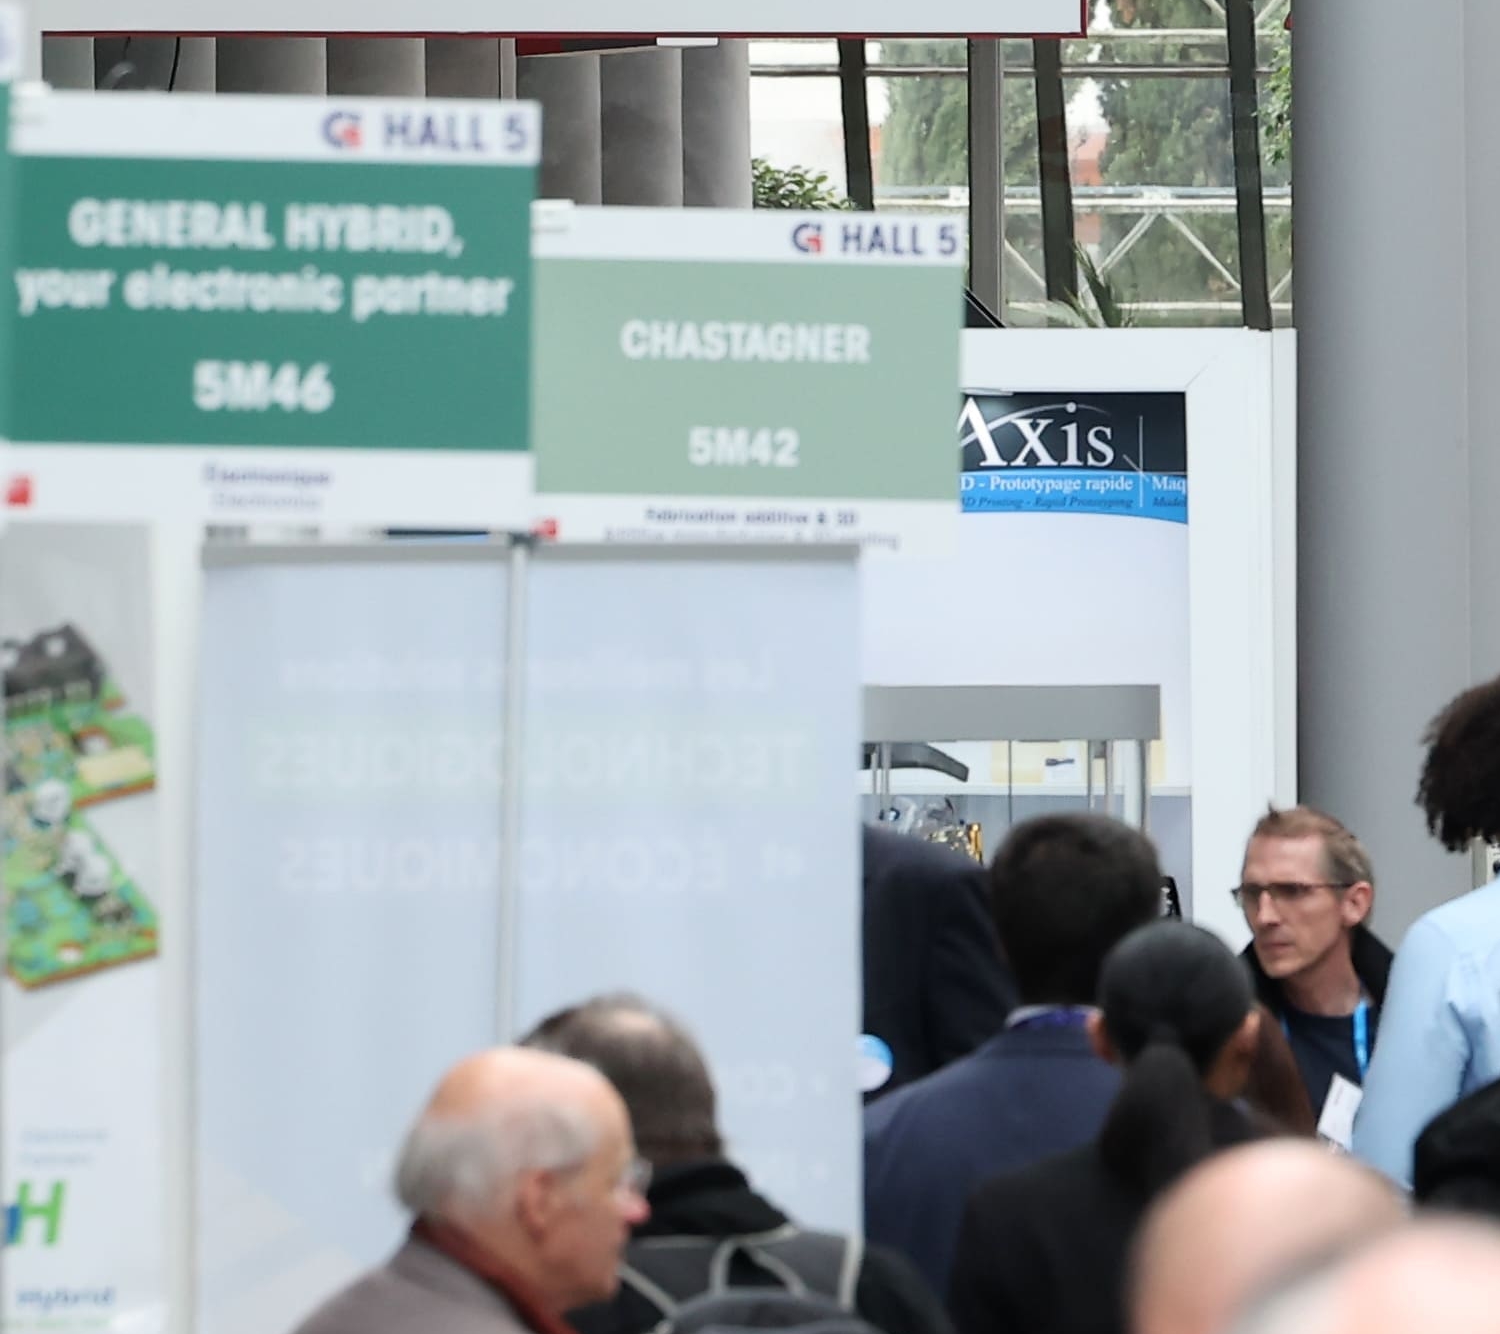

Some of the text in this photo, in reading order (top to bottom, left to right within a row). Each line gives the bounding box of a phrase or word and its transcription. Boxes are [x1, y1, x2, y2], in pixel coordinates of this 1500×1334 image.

[383, 111, 528, 151] HALL 5
[69, 200, 464, 258] GENERAL HYBRID,
[840, 222, 958, 256] HALL 5
[16, 262, 513, 321] your electronic partner
[620, 319, 870, 364] CHASTAGNER
[192, 361, 334, 413] 5M46
[688, 428, 800, 469] 5M42
[957, 397, 1115, 467] Axis
[990, 476, 1080, 494] Prototypage
[1085, 477, 1133, 493] rapide
